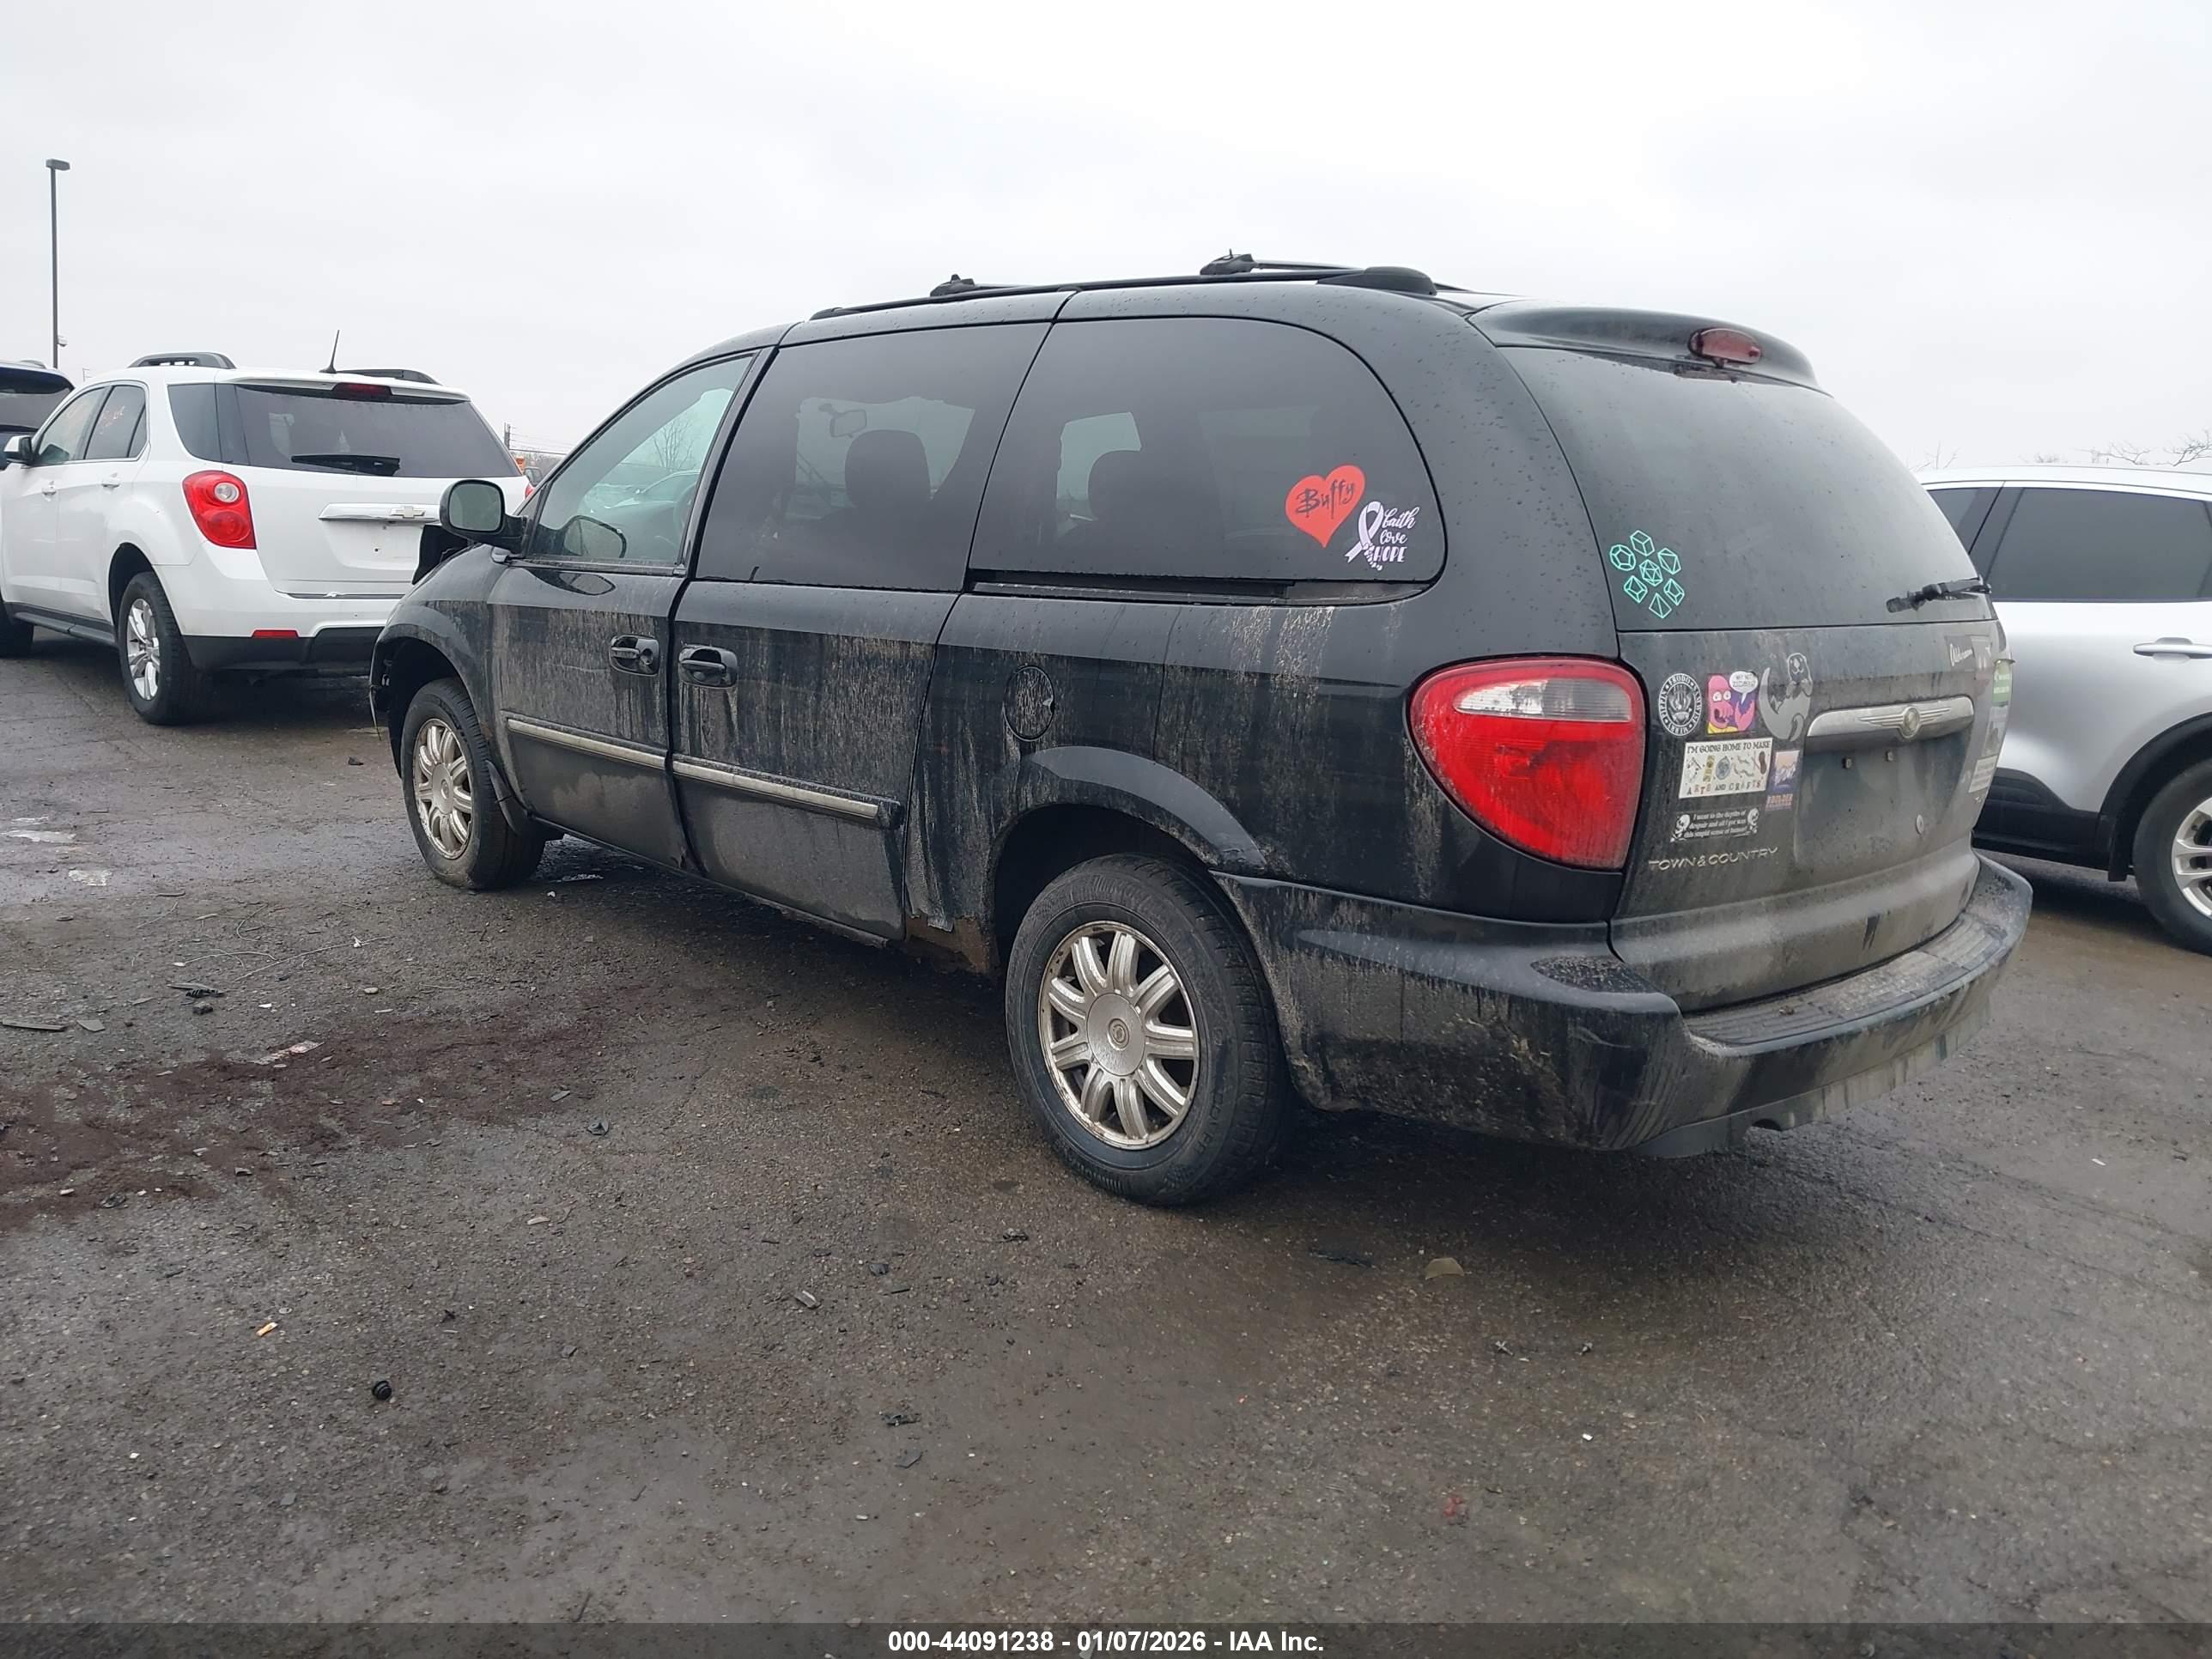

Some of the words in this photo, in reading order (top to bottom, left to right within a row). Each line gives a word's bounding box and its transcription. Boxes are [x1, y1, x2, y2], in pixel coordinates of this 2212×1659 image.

[1295, 478, 1356, 520] Buffy
[1382, 506, 1420, 530] faith
[1379, 529, 1408, 545] love
[1373, 546, 1408, 563] HOPE
[1699, 744, 1721, 753] GOING
[1722, 743, 1741, 752] HOME
[1752, 740, 1771, 750] MAKE
[1715, 783, 1727, 792] AND
